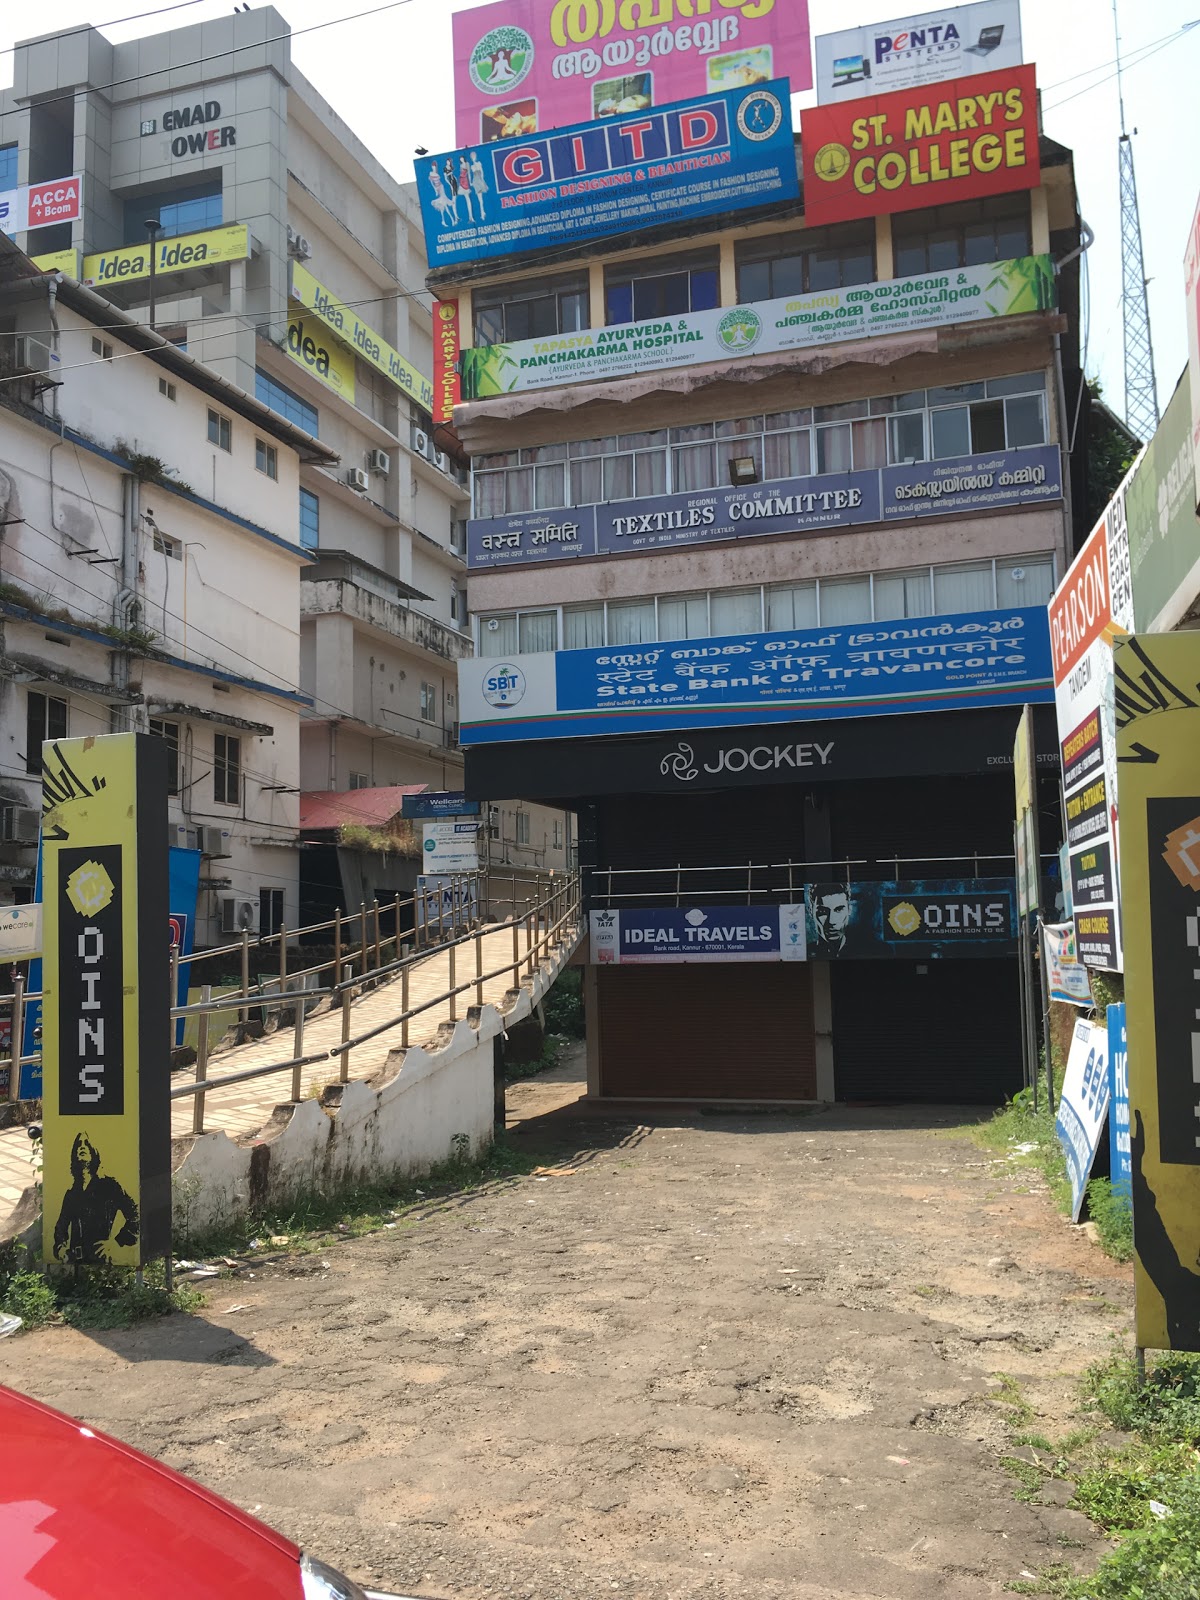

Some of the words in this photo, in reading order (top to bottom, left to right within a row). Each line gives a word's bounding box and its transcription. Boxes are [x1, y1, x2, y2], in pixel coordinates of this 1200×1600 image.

[885, 43, 956, 62] SYSTEMS
[162, 100, 221, 131] EMAD
[851, 114, 893, 151] ST.
[904, 87, 1024, 141] MARY'S
[852, 128, 1027, 195] COLLEGE
[501, 186, 557, 209] FASHION
[560, 171, 633, 198] DESIGNING
[635, 169, 646, 182] &
[648, 150, 731, 179] BEAUTICIAN
[31, 186, 77, 208] ACCA
[44, 203, 71, 217] Bcom
[437, 227, 477, 244] COMPUTERIZED
[478, 222, 501, 235] FASHION
[560, 206, 585, 221] DIPLOMA
[593, 199, 618, 214] FASHION
[650, 186, 688, 201] CERTIFICATE
[688, 181, 712, 195] COURSE
[720, 173, 746, 187] FASHION
[746, 167, 780, 182] DESIGNING
[957, 273, 967, 284] &
[520, 342, 629, 369] PANCHAKARMA
[633, 329, 704, 350] HOSPITAL
[533, 335, 593, 354] TAPASYA
[597, 321, 673, 344] AYURVEDA
[678, 319, 688, 330] &
[593, 353, 642, 367] PANCHAKARMA
[527, 377, 539, 385] Bank
[612, 506, 716, 536] TEXTILES
[728, 488, 863, 521] COMMITTEE
[687, 496, 718, 508] REGIONAL
[724, 493, 747, 503] OFFICE
[753, 490, 763, 500] OF
[768, 488, 781, 498] THE
[530, 521, 579, 546] समिति
[632, 537, 646, 546] GOVT
[649, 535, 656, 544] OF
[658, 534, 672, 543] INDIA
[675, 529, 699, 541] MINISTRY
[701, 529, 708, 538] OF
[710, 525, 735, 536] TEXTILES
[797, 512, 841, 524] KANNUR
[1052, 545, 1107, 672] PEARSON
[597, 667, 658, 684] स्टेट
[674, 661, 731, 678] बैंक
[847, 635, 1025, 663] त्रावणकोर
[487, 674, 519, 691] SBT
[597, 682, 679, 697] State
[688, 672, 771, 690] Bank
[781, 668, 814, 684] of
[836, 654, 1026, 679] Travancore
[1068, 655, 1092, 702] TANDEM
[703, 742, 835, 773] JOCKEY
[429, 798, 466, 806] Wellcare
[3, 921, 29, 930] wecare
[624, 928, 680, 944] IDEAL
[684, 925, 773, 942] TRAVELS
[1078, 918, 1092, 934] CRASH
[1091, 916, 1109, 934] COURSE
[727, 943, 745, 951] Kerala
